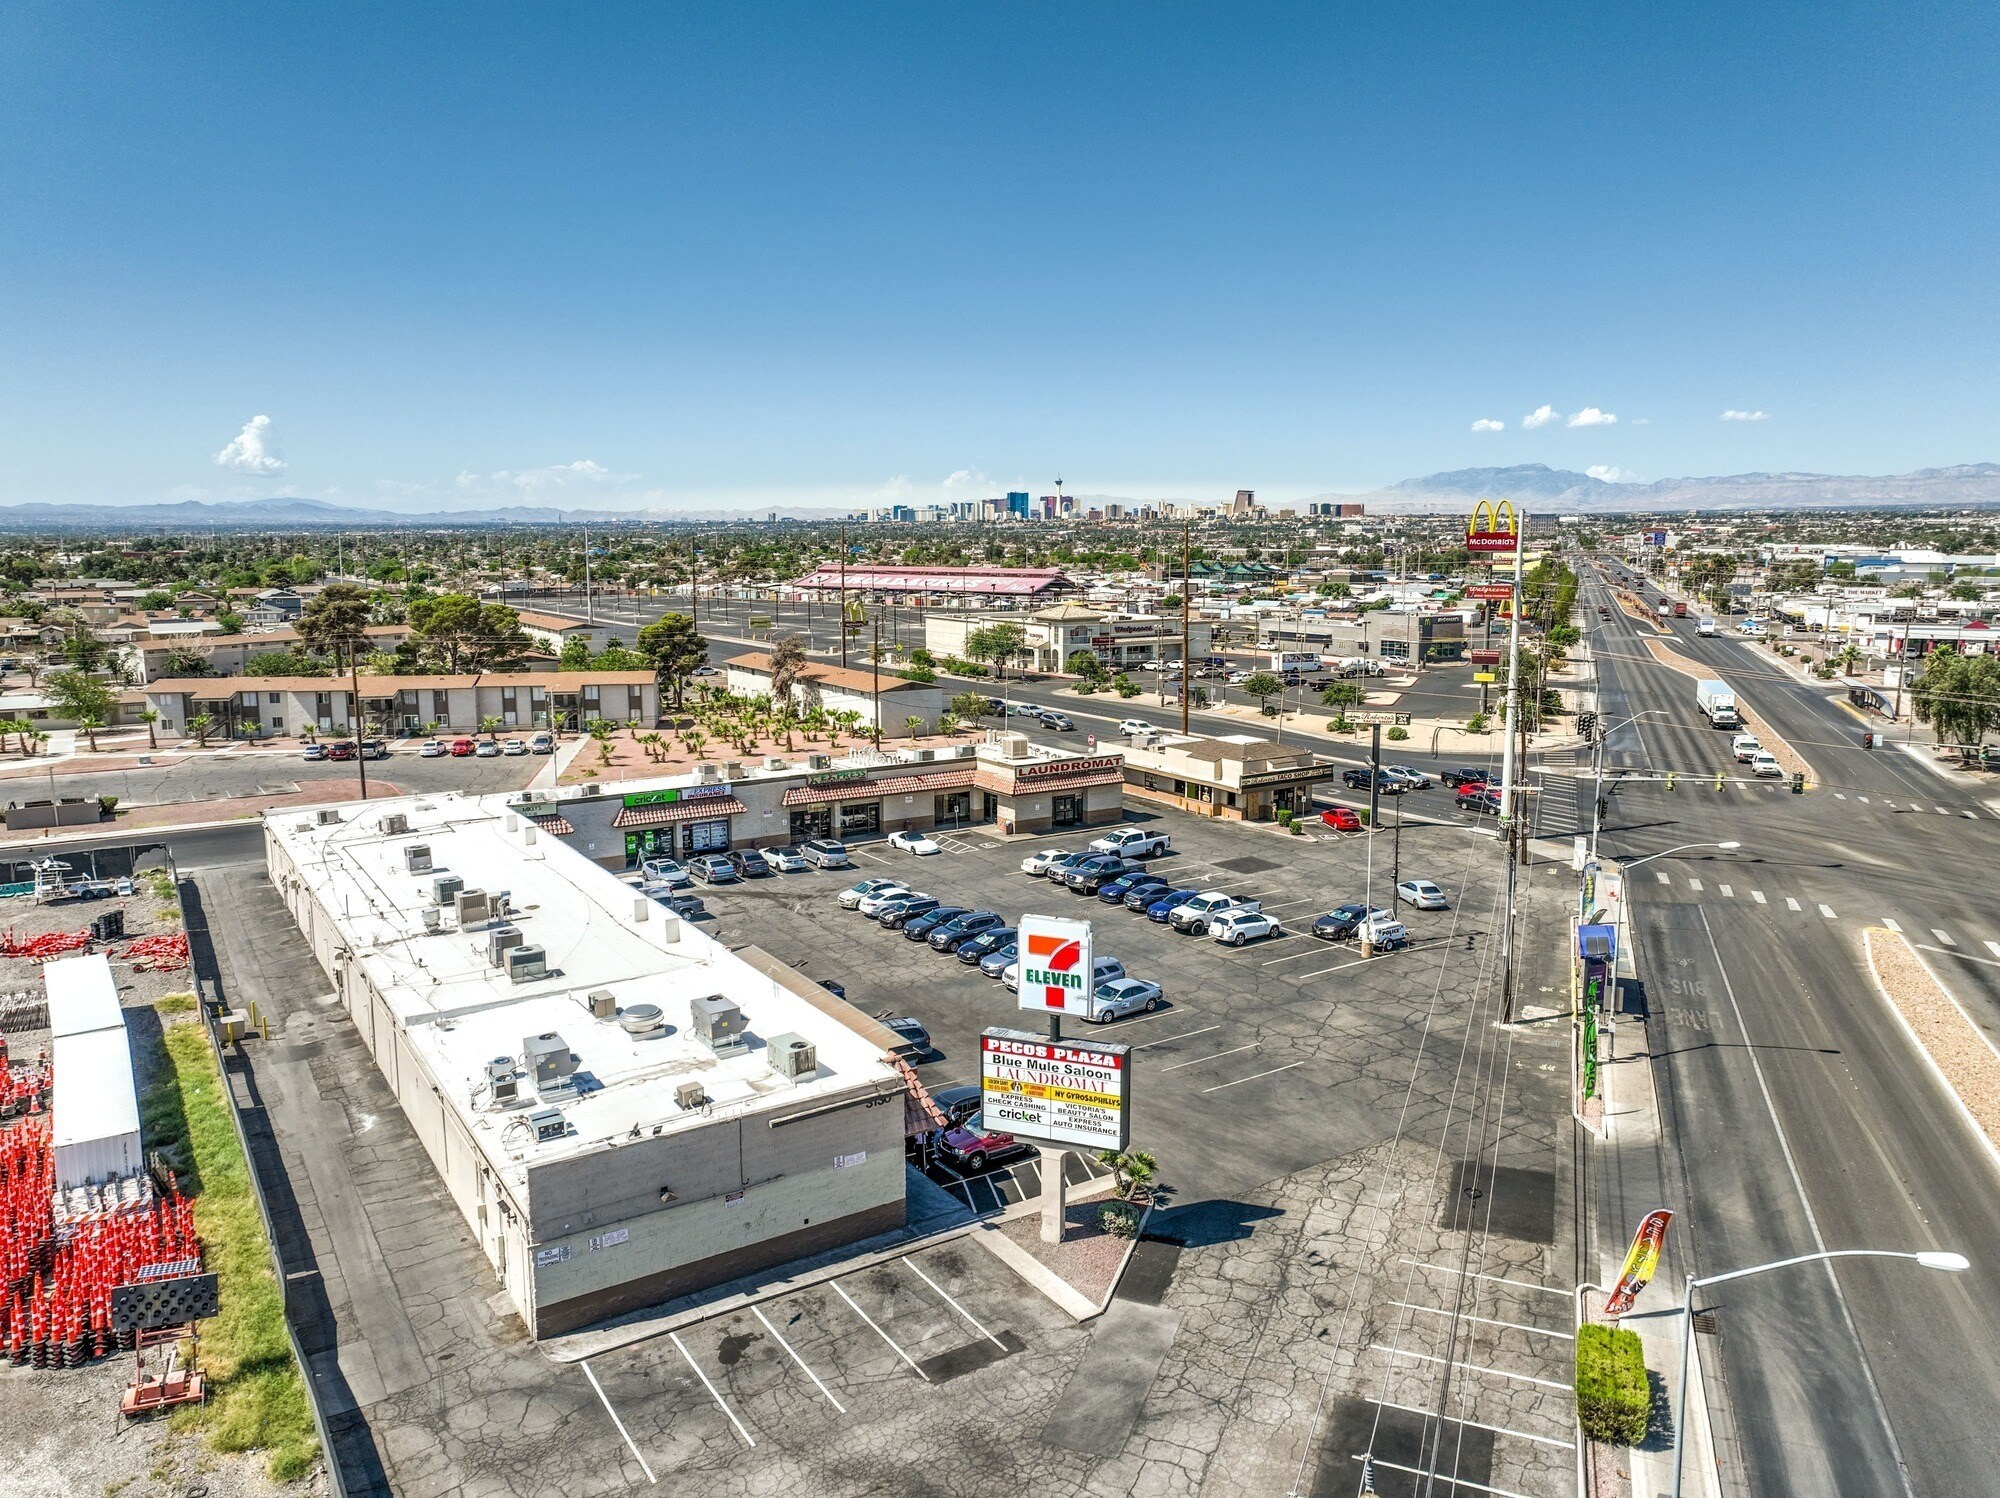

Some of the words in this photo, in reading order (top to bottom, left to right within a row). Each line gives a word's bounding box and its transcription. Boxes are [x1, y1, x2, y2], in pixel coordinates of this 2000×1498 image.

[1469, 538, 1515, 546] McDonald's
[1018, 757, 1123, 777] LAUNDROMAT
[693, 785, 726, 794] EXPRESS
[634, 794, 666, 805] cricket
[1382, 928, 1399, 937] POLICE
[987, 1039, 1047, 1057] PECOS
[1053, 1047, 1116, 1067] PLAZA
[992, 1054, 1022, 1067] Blue
[1027, 1059, 1060, 1073] Mule
[1064, 1064, 1112, 1080] Saloon
[996, 1066, 1108, 1093] LAUNDROMAT
[1001, 1093, 1033, 1103] EXPRESS
[1055, 1090, 1065, 1098] NY
[988, 1097, 1012, 1106] CHECK
[1014, 1101, 1046, 1110] CASHING
[1065, 1103, 1106, 1114] VICTORIA'S
[999, 1109, 1042, 1123] cricket
[1057, 1107, 1087, 1117] BEAUTY
[1088, 1113, 1114, 1121] SALON
[1053, 1120, 1073, 1128] AUTO
[1075, 1123, 1118, 1135] INSURANCE
[1069, 1117, 1102, 1127] EXPRESS
